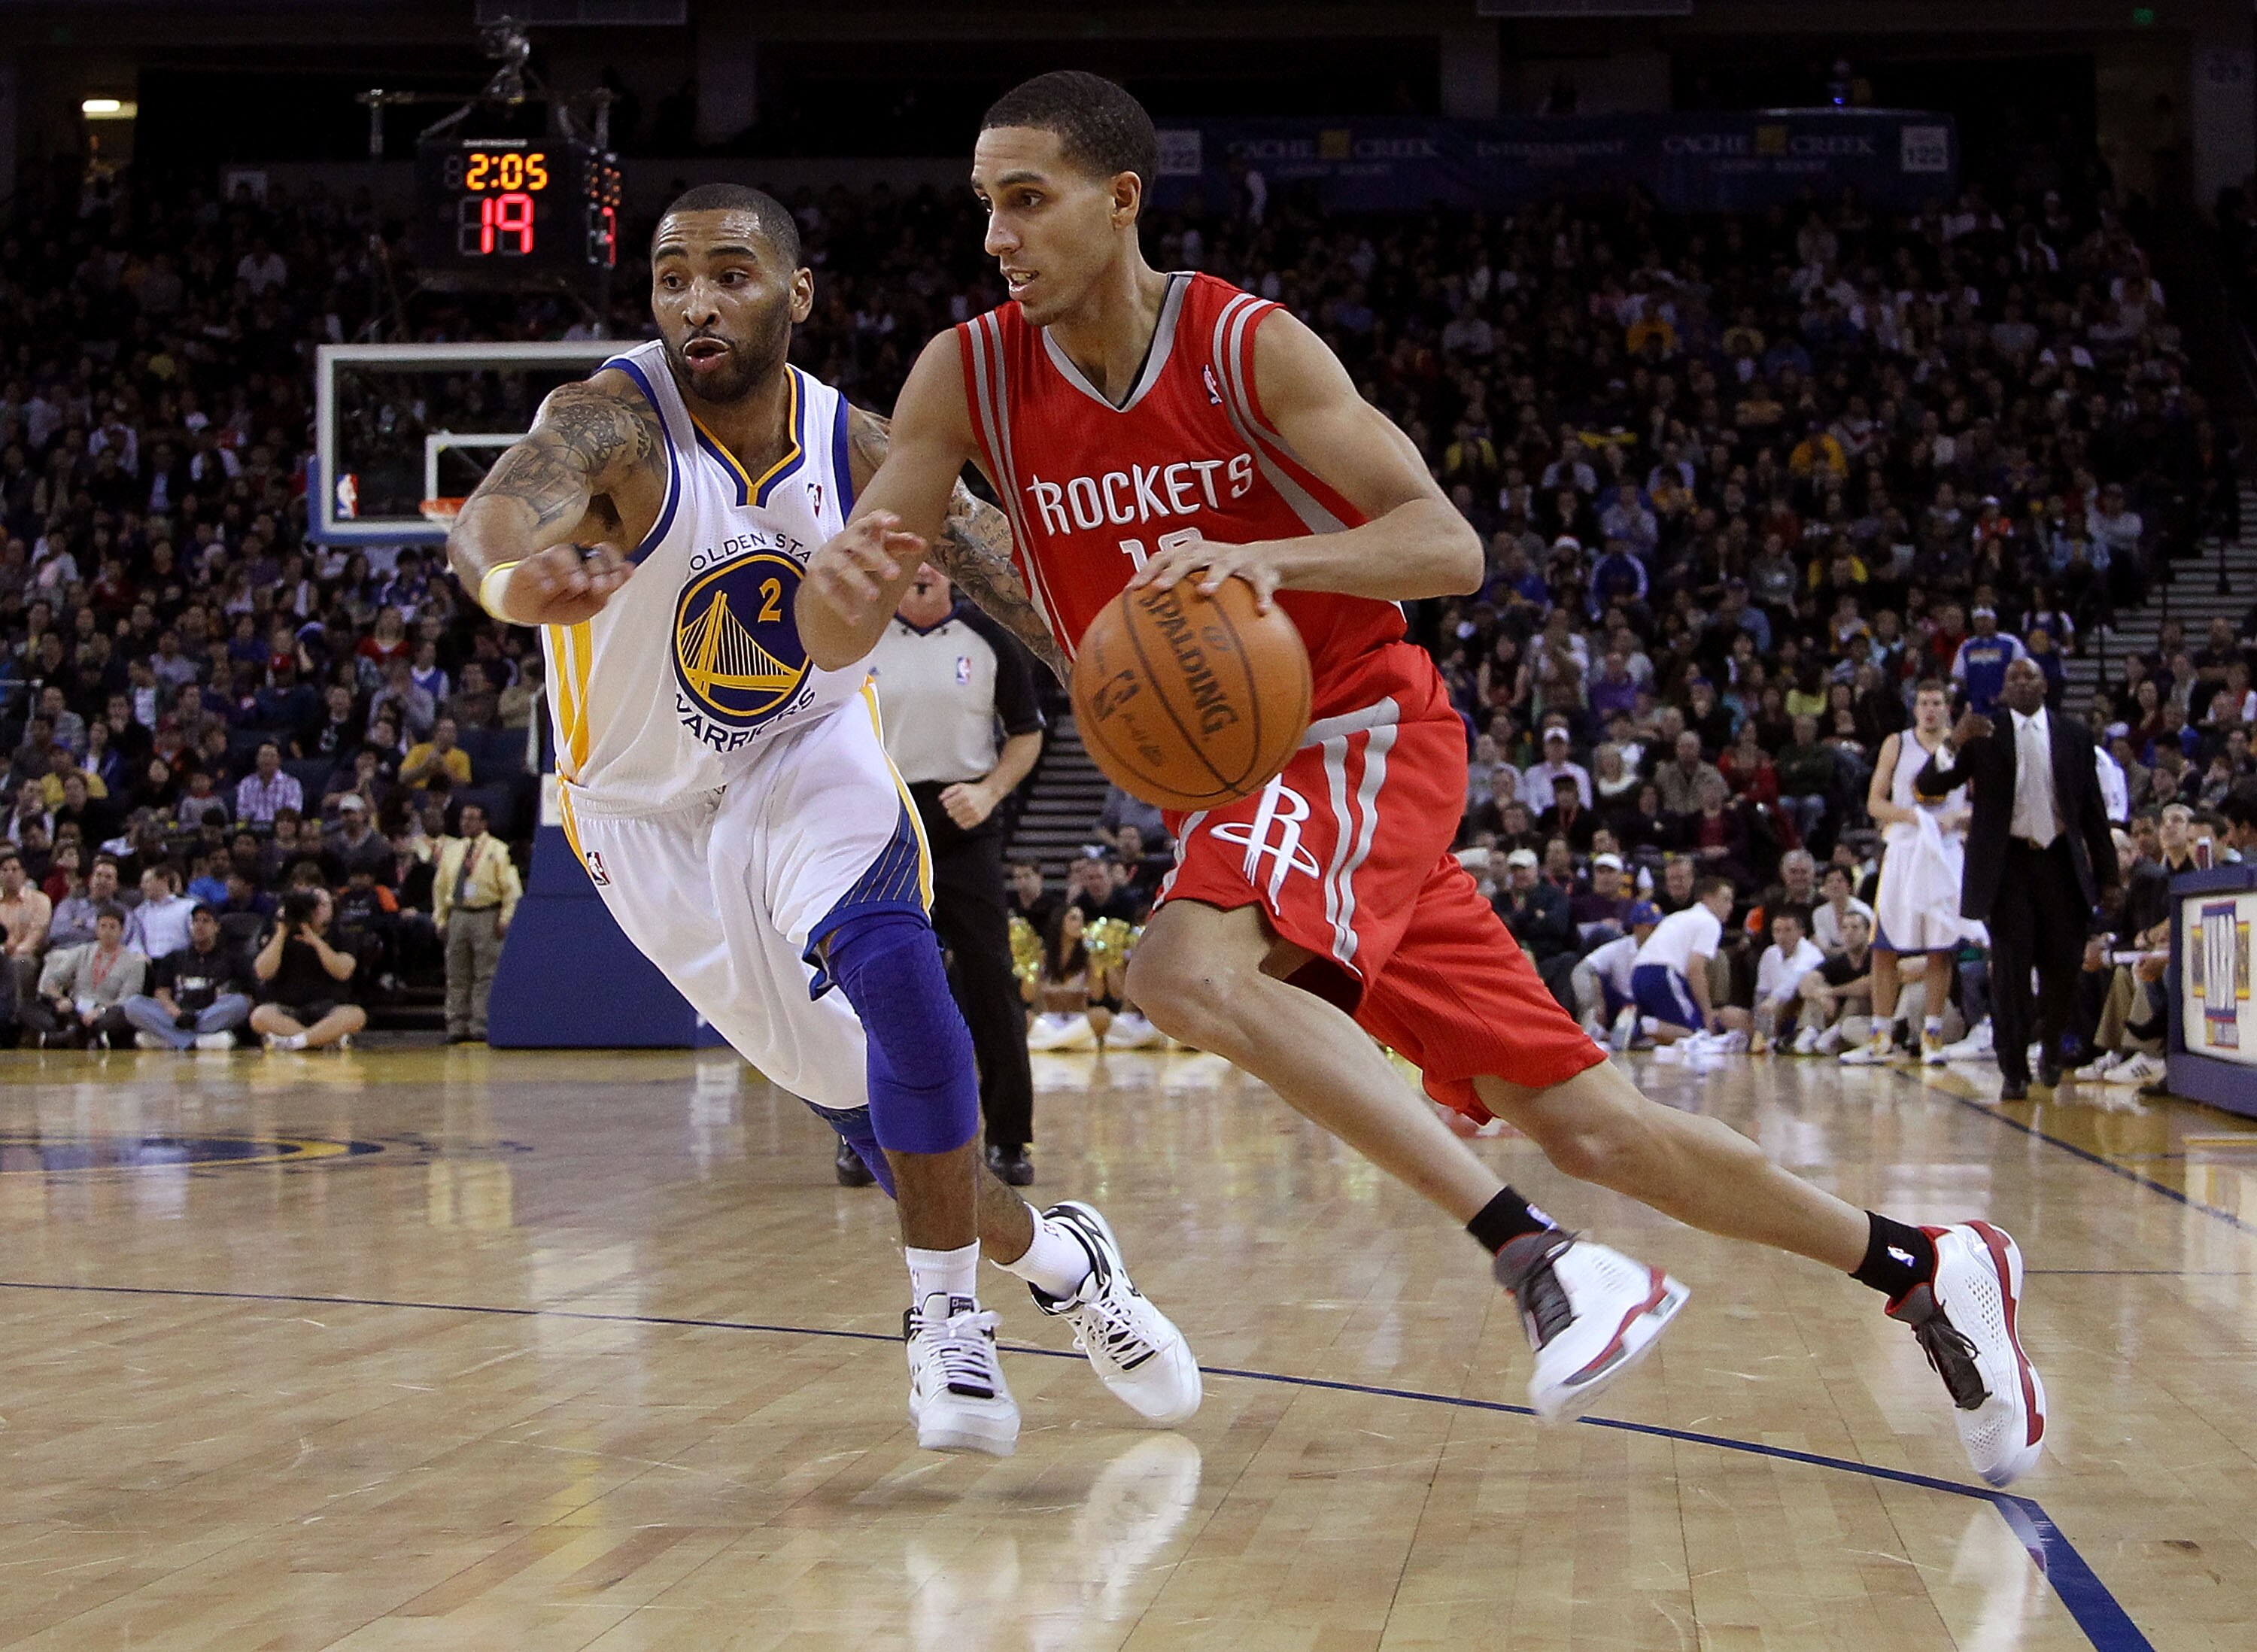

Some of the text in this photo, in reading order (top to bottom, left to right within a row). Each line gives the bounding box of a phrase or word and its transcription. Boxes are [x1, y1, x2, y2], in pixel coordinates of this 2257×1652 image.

[1353, 138, 1440, 157] CREEK
[1789, 135, 1877, 156] CREEK
[466, 153, 548, 191] 2:05
[481, 193, 534, 254] 19
[1025, 452, 1253, 537] ROCKETS
[689, 532, 813, 571] OLDEN STA
[758, 577, 782, 624] 2
[1138, 588, 1239, 736] SPALDING
